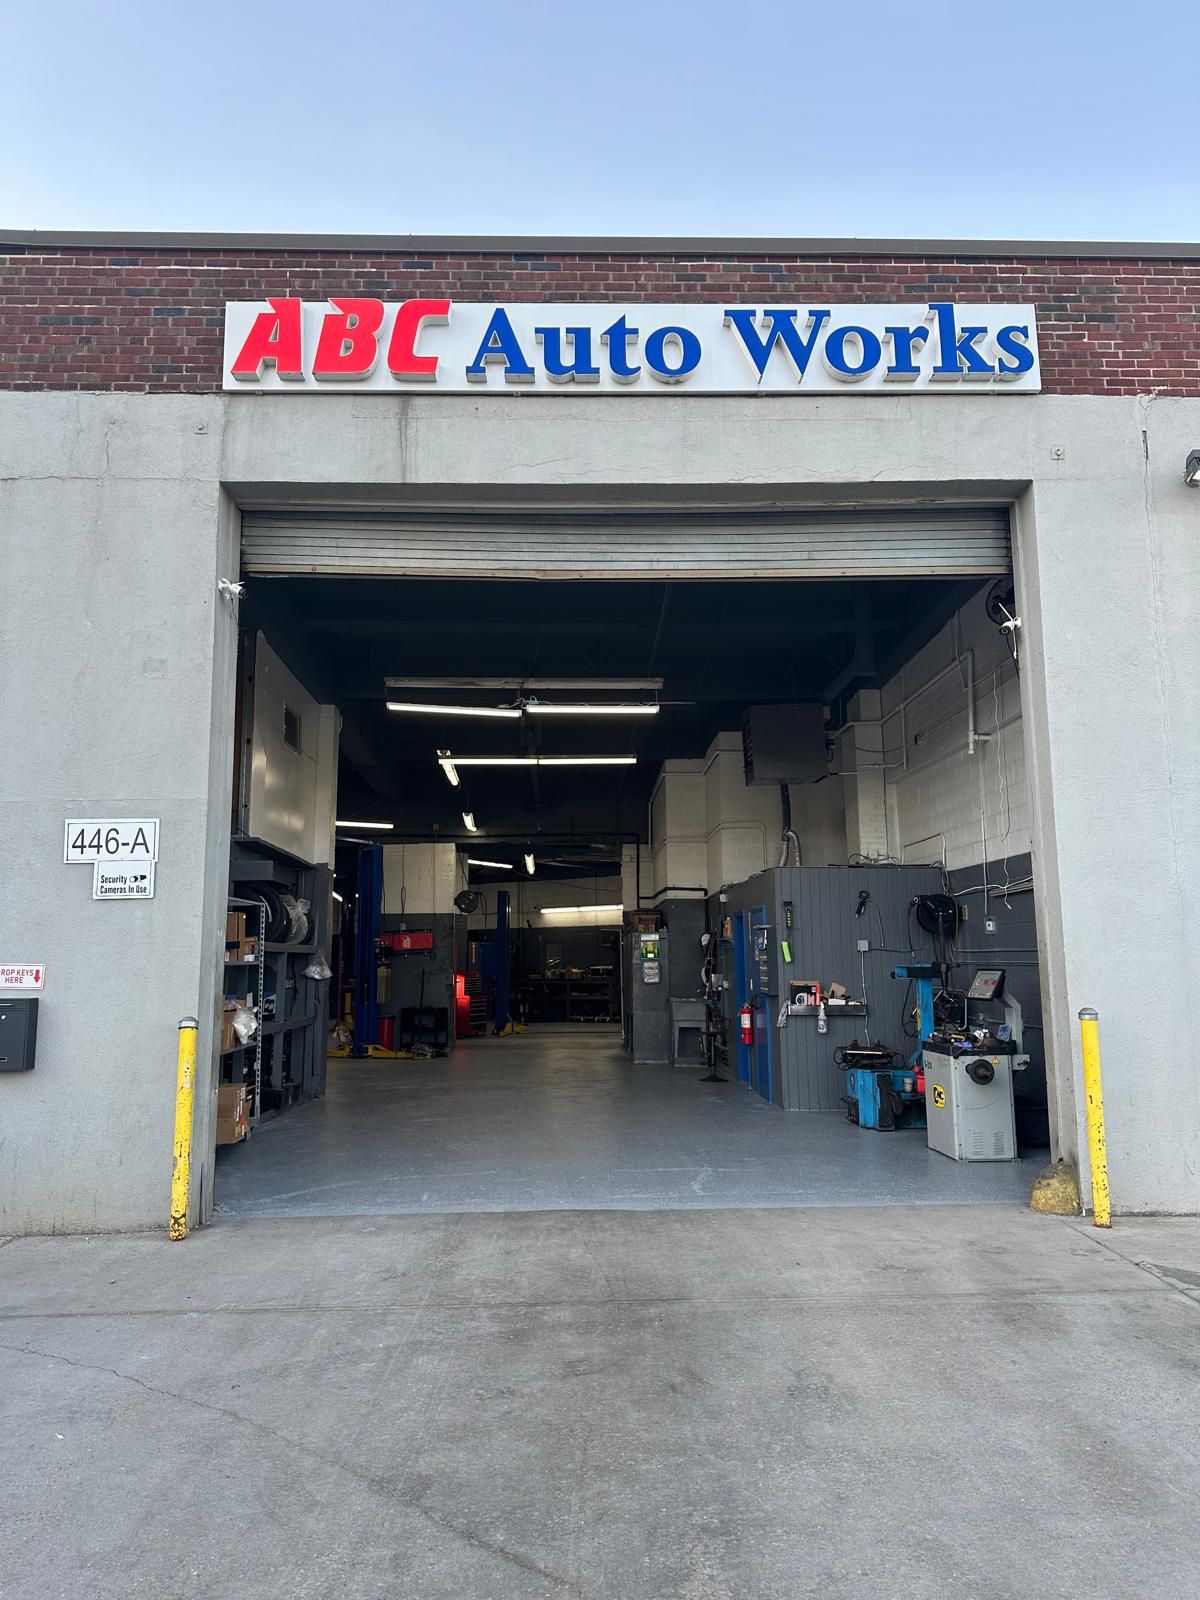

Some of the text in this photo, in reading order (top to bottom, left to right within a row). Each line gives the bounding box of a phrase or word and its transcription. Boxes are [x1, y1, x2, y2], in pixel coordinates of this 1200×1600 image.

[230, 297, 1035, 379] ABC Auto Works
[71, 827, 151, 855] 446-A
[100, 875, 128, 885] Security
[100, 885, 147, 894] Cameras In Use
